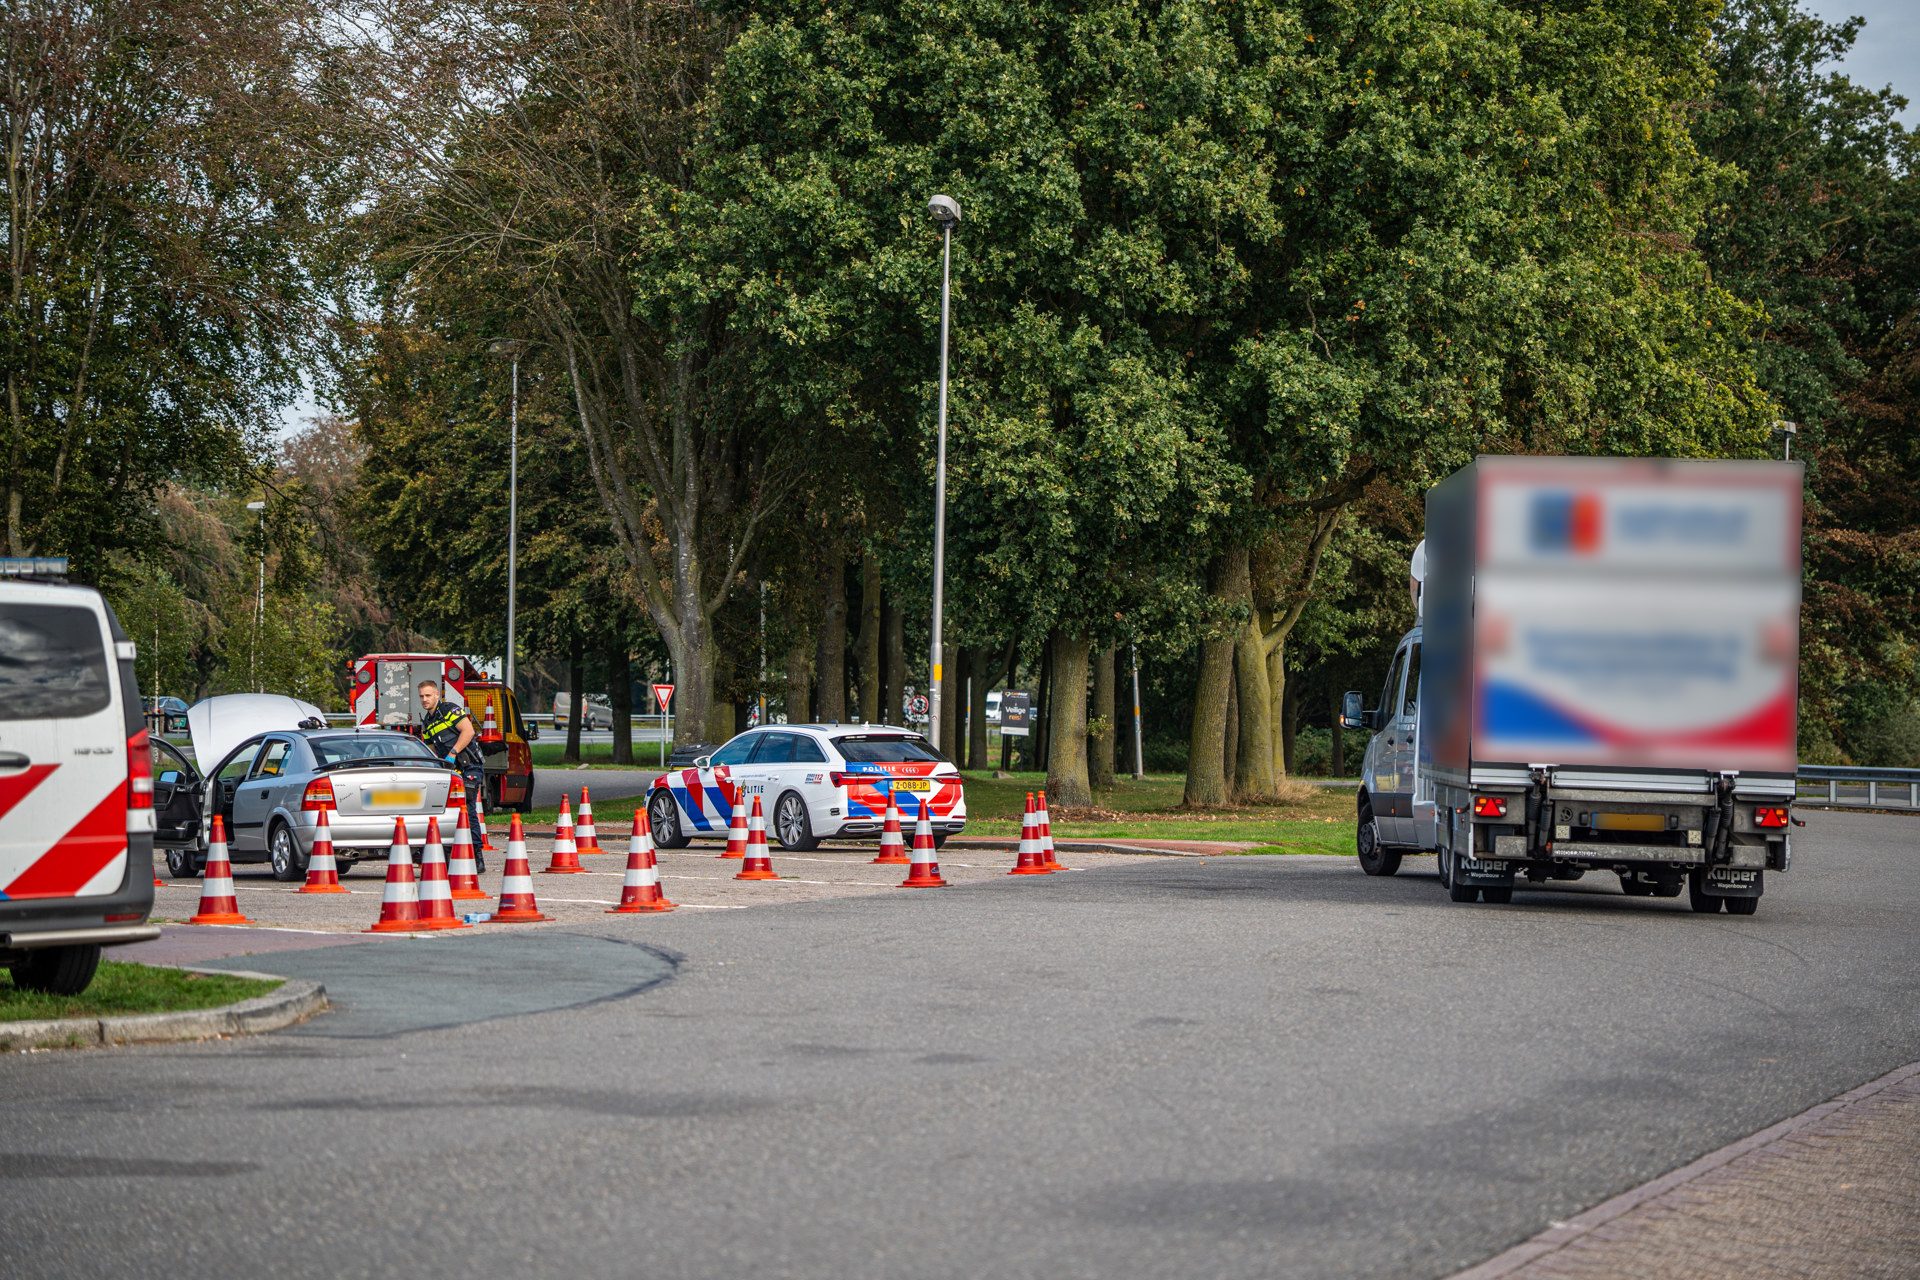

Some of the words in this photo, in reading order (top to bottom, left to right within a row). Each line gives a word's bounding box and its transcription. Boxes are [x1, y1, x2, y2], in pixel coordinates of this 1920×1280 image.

[1005, 706, 1026, 714] Veilige
[1461, 857, 1509, 872] Kuiper
[1707, 867, 1757, 883] Kuiper
